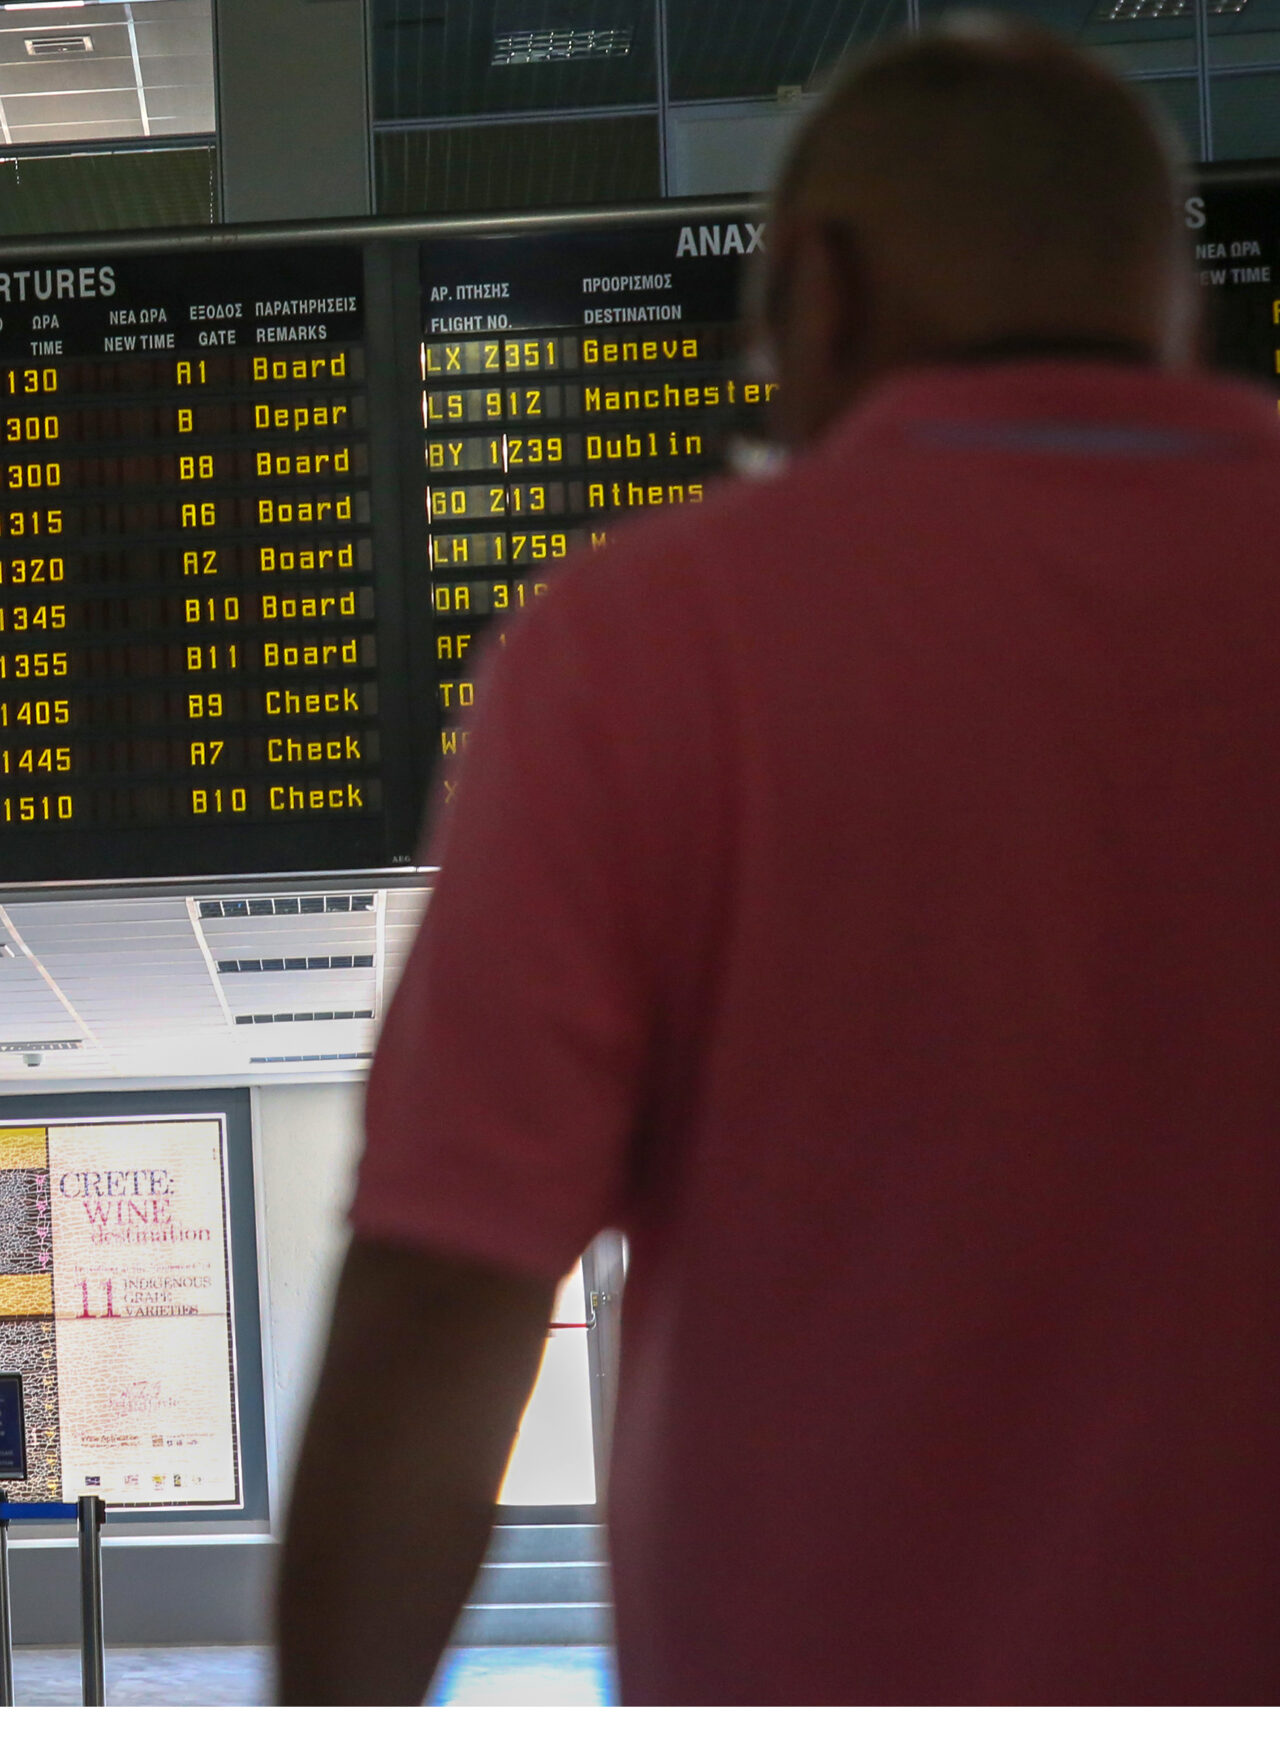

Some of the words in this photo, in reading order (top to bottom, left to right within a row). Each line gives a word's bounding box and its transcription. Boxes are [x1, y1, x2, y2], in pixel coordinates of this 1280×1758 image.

[583, 274, 672, 292] ΠΡΟΟΡΙΣΜΟΣ
[1230, 267, 1270, 283] TIME
[110, 310, 136, 325] ΝΕΑ
[140, 308, 167, 323] ΩΡΑ
[190, 303, 242, 320] ΕΞΟΔΟΣ
[256, 297, 356, 316] ΠΑΡΑΤΗΡΗΣΕΙΣ
[584, 305, 681, 324] DESTINATION
[33, 314, 59, 329] ΩΡΑ
[257, 325, 326, 342] REMARKS
[432, 316, 482, 333] FLIGHT
[487, 315, 513, 331] NO.
[31, 341, 62, 355] TIME
[105, 336, 136, 351] NEW
[140, 334, 174, 349] TIME
[199, 330, 235, 346] GATE
[176, 360, 206, 385] A1
[253, 352, 346, 381] Board
[427, 346, 462, 372] LX
[484, 341, 555, 369] 2351
[583, 339, 698, 364] Geneva
[429, 394, 463, 420] LS
[485, 390, 542, 417] 912
[585, 378, 779, 412] Manchester
[178, 408, 193, 433] B
[254, 404, 347, 432] Depar
[179, 455, 214, 480] B8
[256, 447, 349, 476] Board
[429, 442, 463, 468] BY
[489, 437, 563, 465] 1239
[586, 431, 702, 460] Dublin
[181, 502, 216, 528] A6
[258, 495, 351, 524] Board
[489, 486, 545, 513] 213
[589, 481, 703, 508] Athens
[183, 550, 218, 575] A2
[260, 543, 353, 572] Board
[433, 537, 469, 564] LH
[494, 533, 567, 561] 1759
[185, 597, 239, 623] B10
[262, 591, 355, 619] Board
[0, 652, 68, 679] 1355
[187, 644, 236, 670] B11
[264, 639, 357, 667] Board
[0, 700, 69, 727] 1405
[188, 693, 223, 718] B9
[266, 687, 359, 715] Check
[2, 747, 71, 774] 1445
[190, 740, 224, 766] A7
[268, 735, 361, 763] Check
[4, 795, 73, 822] 1510
[192, 788, 247, 814] B10
[269, 783, 363, 811] Check
[59, 1169, 175, 1199] CRETE:
[82, 1199, 172, 1226] WINE
[91, 1225, 211, 1245] destination
[74, 1277, 121, 1318] 11
[123, 1276, 212, 1290] INDIGENOUS
[125, 1304, 199, 1317] VARIETIES
